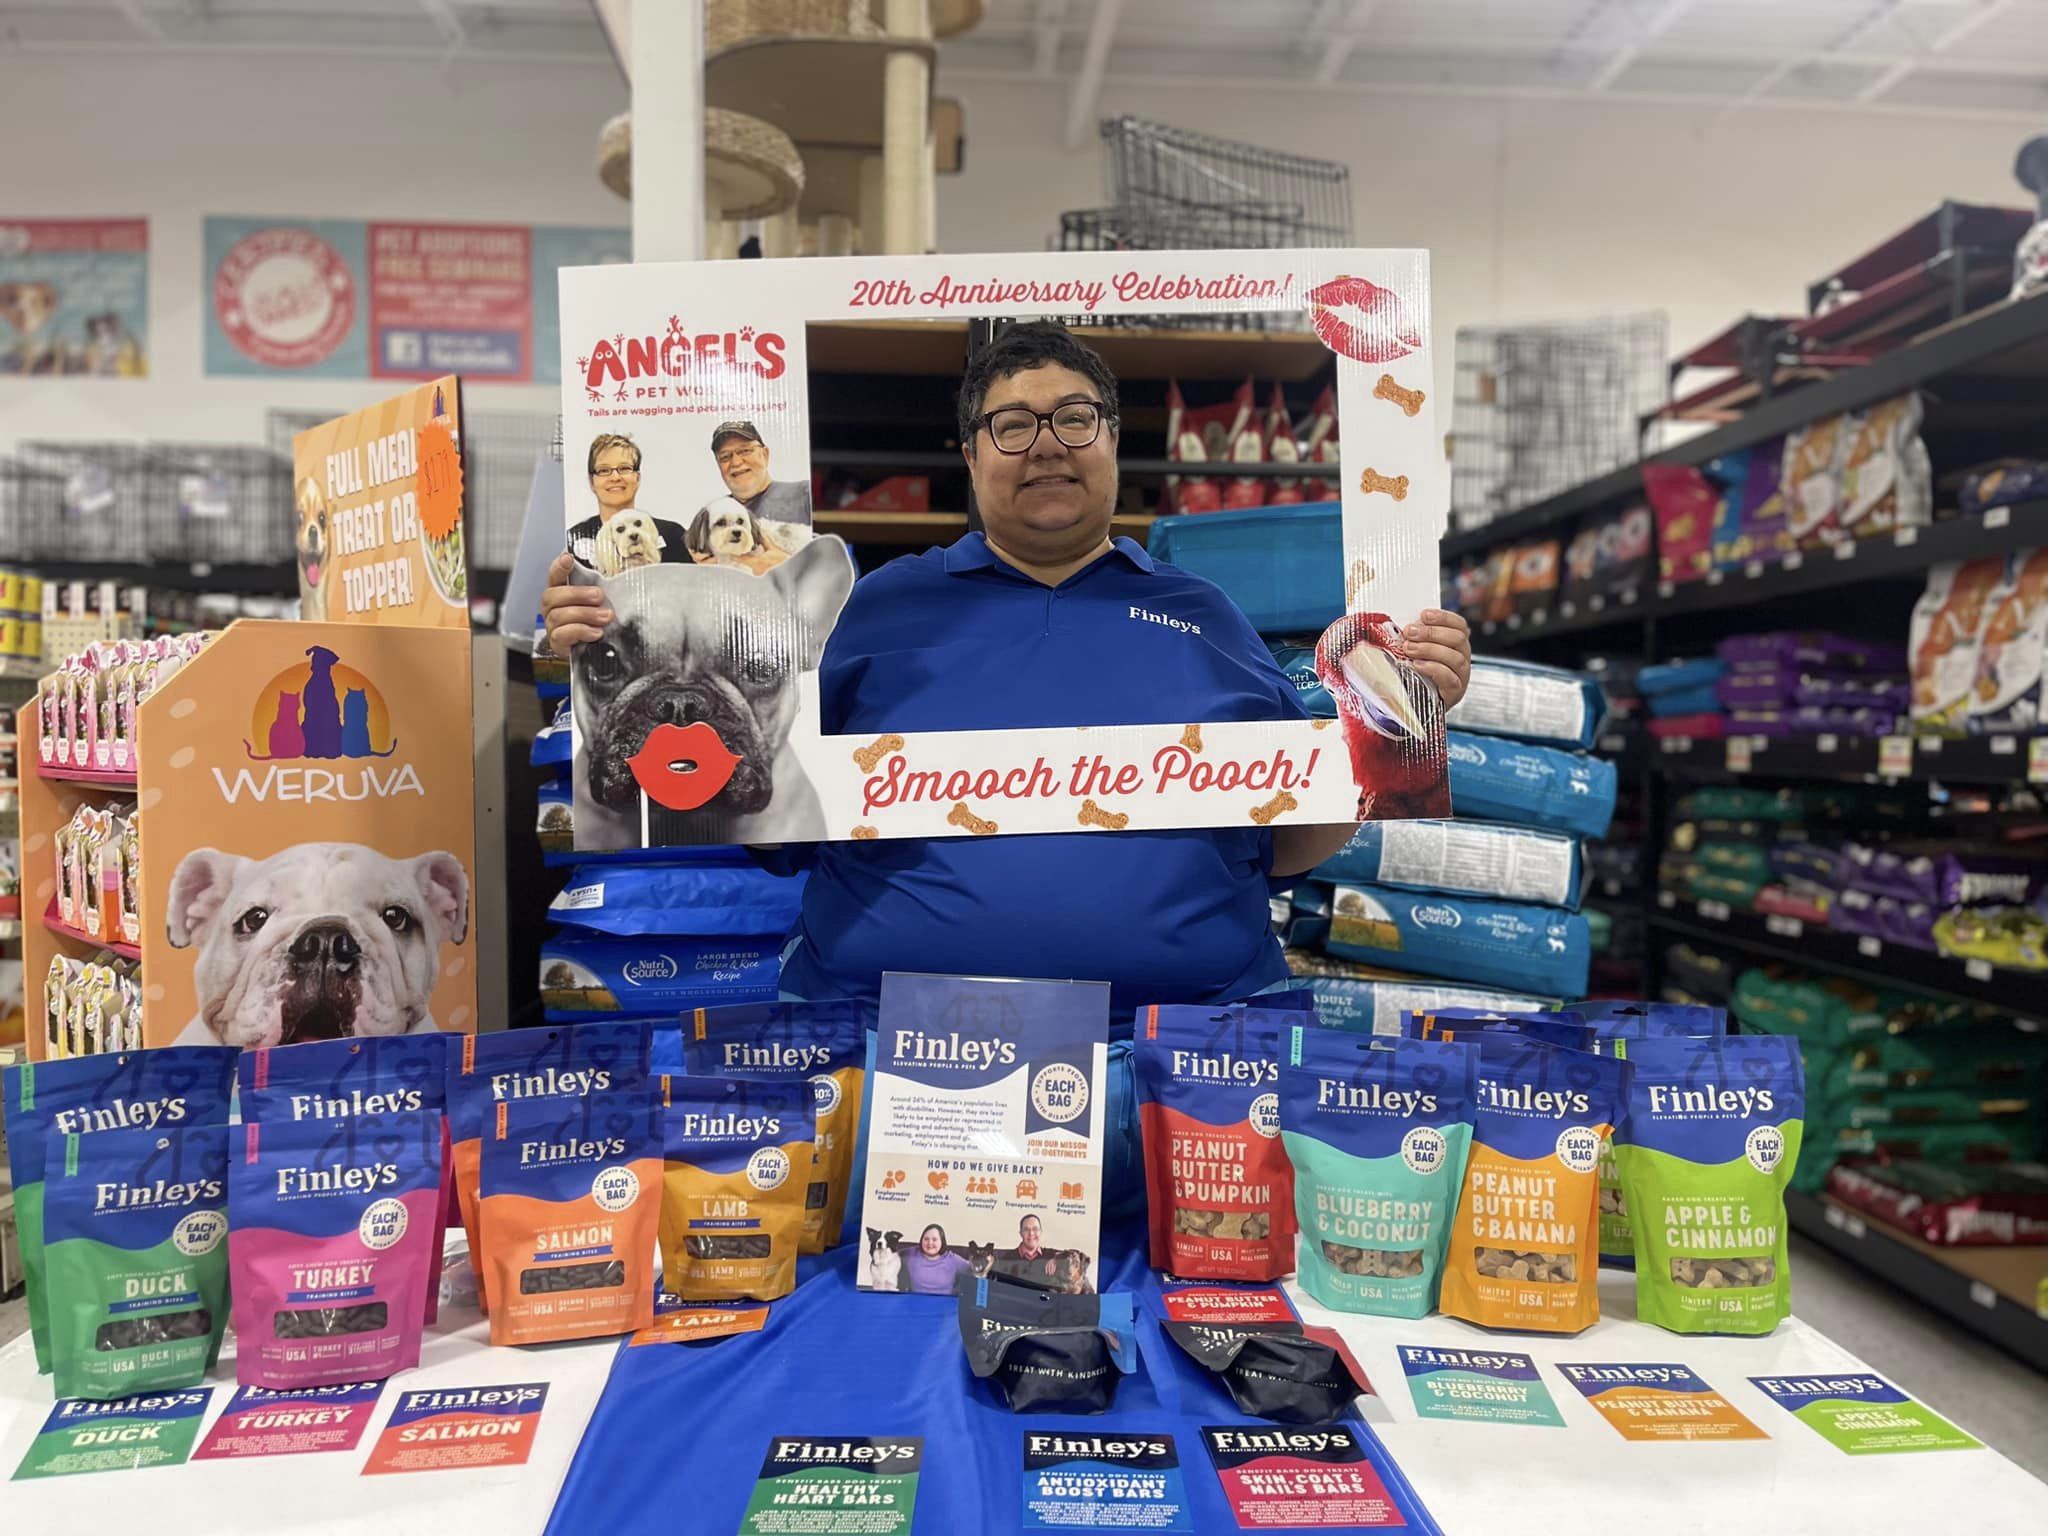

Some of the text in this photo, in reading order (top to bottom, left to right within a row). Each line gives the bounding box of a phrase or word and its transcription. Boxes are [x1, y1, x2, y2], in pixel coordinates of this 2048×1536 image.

[850, 272, 1293, 311] 20th Anniversary Celebration!
[636, 387, 668, 398] PET
[326, 428, 418, 500] FULL MEAL
[333, 492, 417, 557] TREAT OR
[343, 557, 413, 613] TOPPER!
[212, 764, 425, 804] WERUVA
[863, 746, 1320, 817] Smooch the Pooch!
[639, 960, 665, 970] Nutri
[631, 967, 669, 978] Source
[712, 971, 742, 981] Recipe
[723, 1043, 831, 1071] Finley's
[893, 1030, 1016, 1071] Finley's
[1172, 1050, 1278, 1087] Finley's
[492, 1067, 611, 1100] Finley's
[1045, 1080, 1075, 1093] EACH
[1048, 1094, 1071, 1107] BAG
[1318, 1079, 1437, 1118] Finley's
[1477, 1079, 1589, 1119] Finley's
[1648, 1084, 1774, 1119] Finley's
[56, 1098, 186, 1134] Finley's
[1259, 1106, 1279, 1116] EAC
[683, 1113, 781, 1140] Finley's
[1262, 1117, 1279, 1127] BAG
[1027, 1139, 1042, 1147] JOIN
[1412, 1139, 1438, 1151] EACH
[1567, 1139, 1594, 1150] EACH
[1756, 1140, 1779, 1151] EACH
[521, 1138, 625, 1163] Finley's
[1172, 1139, 1247, 1161] PEANUT
[1571, 1150, 1592, 1161] BAG
[1415, 1151, 1435, 1163] BAG
[757, 1159, 781, 1169] EACH
[927, 1160, 1044, 1175] HOW DO WE GIVE BACK?
[759, 1169, 777, 1179] BAG
[1172, 1160, 1245, 1183] BUTTER
[277, 1163, 398, 1194] Finley's
[603, 1178, 628, 1190] EACH
[1472, 1172, 1556, 1197] PEANUT
[95, 1179, 222, 1209] Finley's
[606, 1189, 626, 1200] BAG
[1185, 1182, 1270, 1204] PUMPKIN
[965, 1197, 997, 1205] Community
[1005, 1201, 1048, 1209] Transportation
[1317, 1192, 1432, 1221] BLUEBERRY
[1472, 1195, 1555, 1220] BUTTER
[703, 1201, 748, 1217] LAMB
[1665, 1205, 1751, 1225] APPLE &
[372, 1212, 398, 1225] EACH
[187, 1223, 216, 1233] EACH
[372, 1224, 394, 1237] BAG
[1319, 1214, 1431, 1243] & COCONUT
[1473, 1217, 1576, 1245] & BANANA
[188, 1233, 210, 1243] BAG
[537, 1226, 613, 1250] SALMON
[1666, 1224, 1776, 1249] CINNAMON
[1176, 1241, 1204, 1253] LIMITED
[1211, 1249, 1233, 1261] USA
[293, 1264, 372, 1290] TURKEY
[126, 1274, 187, 1298] DUCK
[1479, 1285, 1511, 1297] LIMITED
[1168, 1295, 1278, 1303] PEANUT BUTTER
[1360, 1287, 1383, 1299] USA
[1203, 1301, 1264, 1309] PUMPKIN
[1520, 1294, 1543, 1306] USA
[1681, 1295, 1712, 1306] LIMITED
[1720, 1300, 1742, 1312] USA
[673, 1315, 736, 1327] LAMB
[286, 1350, 306, 1361] USA
[1405, 1348, 1527, 1369] Finley's
[113, 1359, 135, 1372] USA
[1009, 1364, 1107, 1380] TREAT WITH KINDNESS
[1566, 1366, 1691, 1382] Finley's
[1759, 1378, 1883, 1395] Finley's
[406, 1388, 542, 1408] Finley's
[1449, 1390, 1528, 1403] COCONUT
[1598, 1400, 1728, 1409] PEANUT BUTTER
[237, 1409, 353, 1429] TURKEY
[1835, 1411, 1884, 1422] APPLE
[400, 1421, 522, 1442] SALMON
[1834, 1420, 1923, 1431] CINNAMON
[72, 1427, 162, 1447] DUCK
[1212, 1431, 1350, 1451] Finley's
[775, 1442, 915, 1463] Finley's
[1030, 1436, 1167, 1458] Finley's
[1038, 1477, 1167, 1489] ANTIOXIDANT
[1240, 1474, 1363, 1486] SKIN, COAT &
[794, 1485, 880, 1495] HEALTHY
[1042, 1487, 1164, 1498] BOOST BARS
[1251, 1483, 1365, 1494] NAILS BARS
[773, 1494, 896, 1504] HEART BARS
